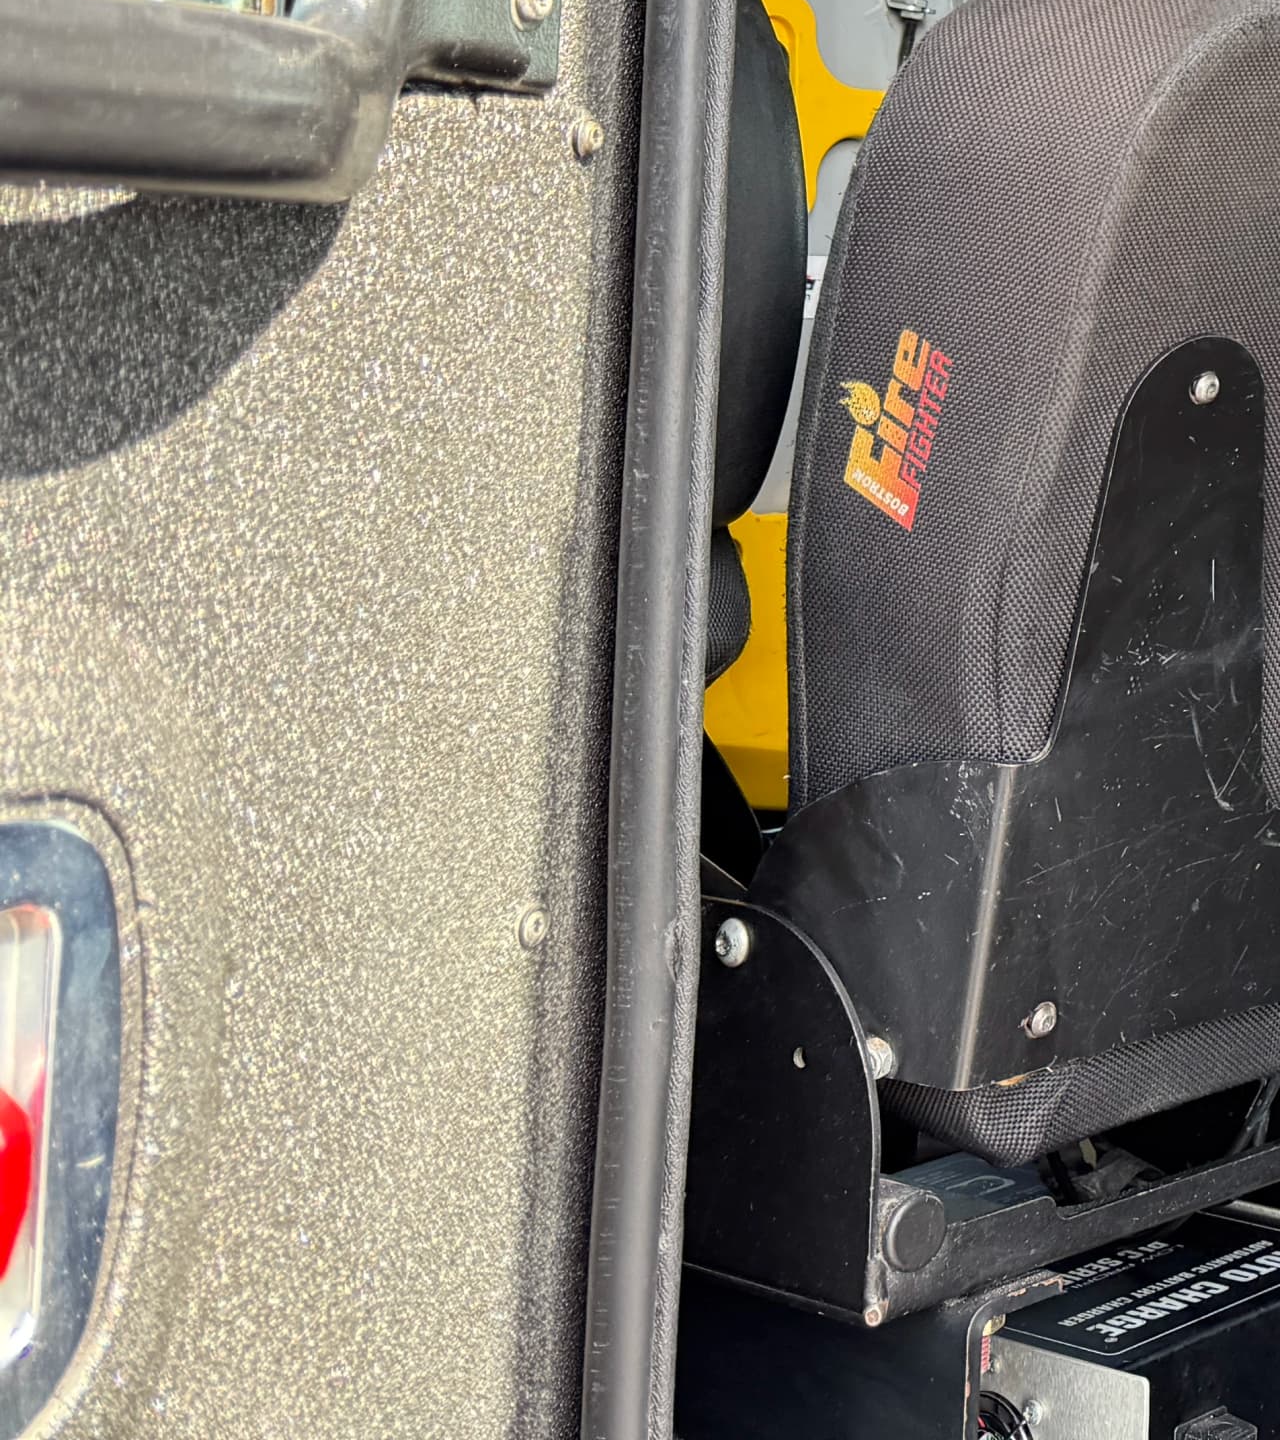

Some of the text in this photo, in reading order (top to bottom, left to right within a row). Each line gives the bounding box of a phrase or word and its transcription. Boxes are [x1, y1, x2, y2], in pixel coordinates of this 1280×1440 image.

[839, 328, 931, 532] Fire
[901, 349, 954, 490] FIGHTER
[852, 468, 909, 516] BOSTROM
[1057, 1239, 1274, 1328] AUTOMATIC BATTERY CHARGER
